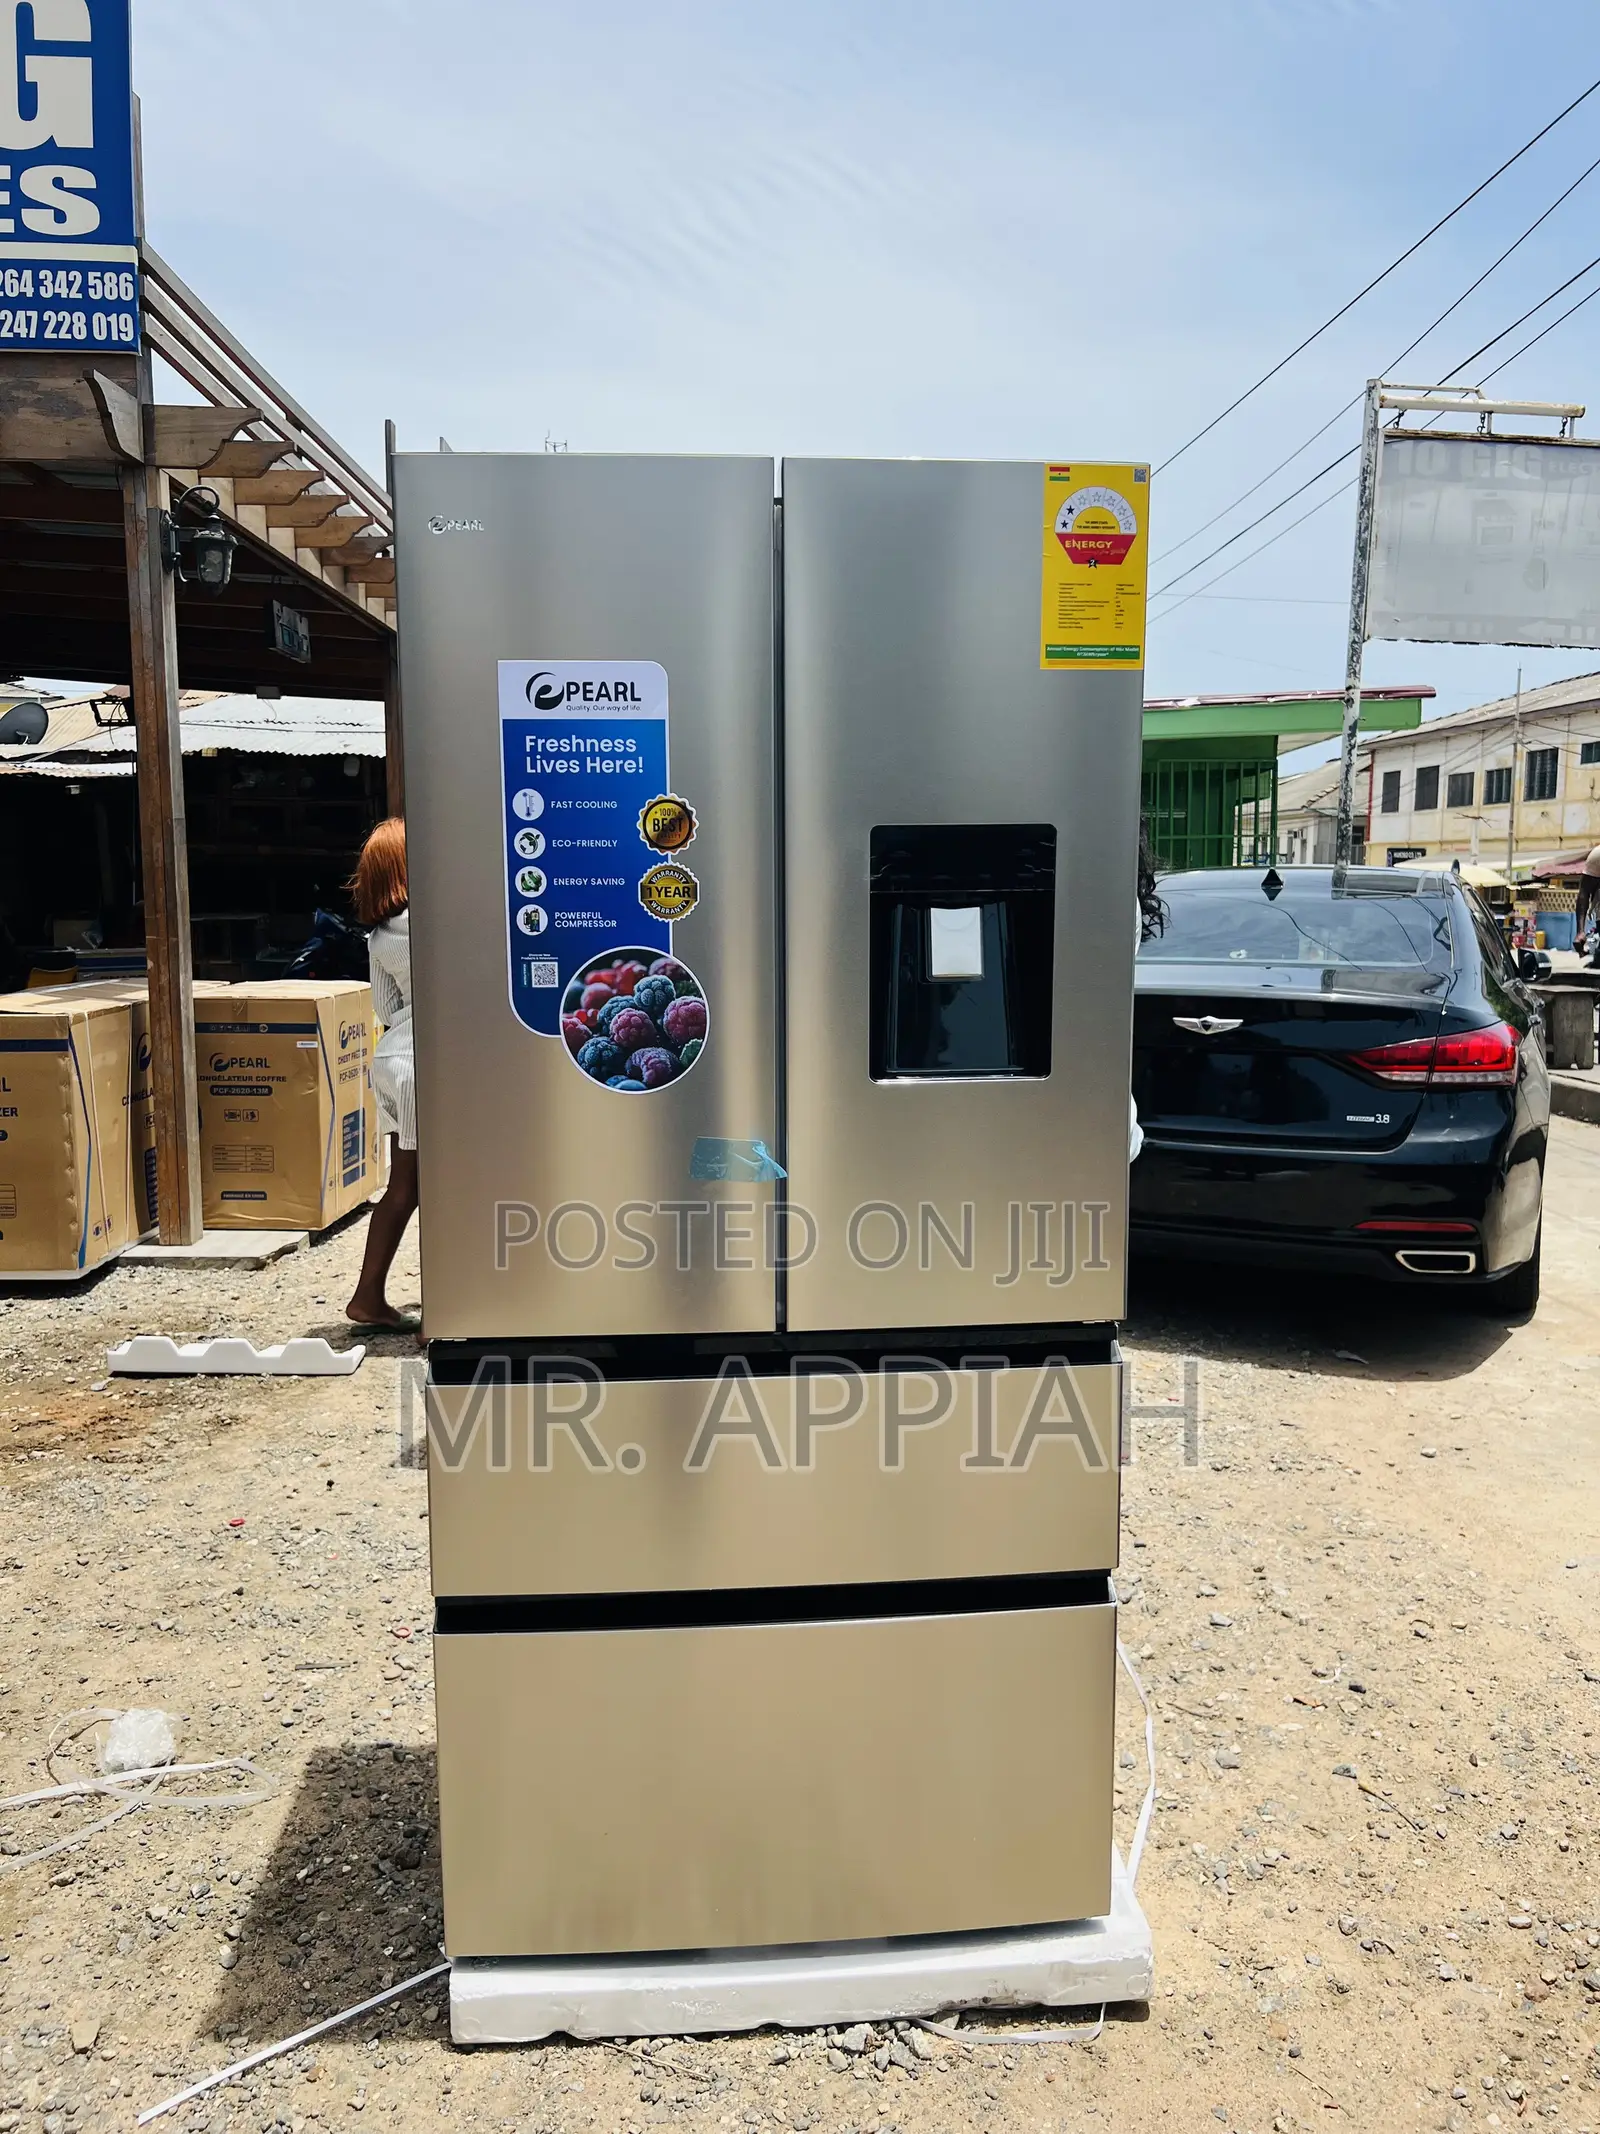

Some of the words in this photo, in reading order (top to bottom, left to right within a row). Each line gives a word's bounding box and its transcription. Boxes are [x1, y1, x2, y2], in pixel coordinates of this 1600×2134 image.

[0, 0, 94, 150] G
[38, 269, 83, 299] 342
[88, 271, 134, 301] 586
[0, 309, 38, 339] 247
[43, 310, 88, 340] 228
[92, 312, 134, 342] 019
[1391, 440, 1449, 476] 10
[447, 519, 485, 531] PEARL
[1065, 538, 1113, 550] ENERGY
[566, 681, 642, 702] PEARL
[606, 705, 621, 713] way
[525, 734, 637, 753] Freshness
[526, 754, 580, 774] Lives
[586, 756, 644, 774] Here!
[550, 800, 574, 809] FAST
[575, 800, 618, 809] COOLING
[660, 807, 678, 817] 100%
[652, 817, 684, 833] BEST
[552, 839, 618, 848] ECO-FRIENDLY
[553, 877, 589, 886] ENERGY
[590, 877, 626, 886] SAVING
[650, 870, 687, 884] WARRANTY
[646, 886, 653, 898] 1
[654, 886, 691, 898] YEAR
[650, 900, 687, 915] WARRANTY
[554, 911, 603, 920] POWERFUL
[554, 920, 617, 928] COMPRESSOR
[351, 1048, 368, 1060] FREEER
[230, 1057, 271, 1068] PEARL
[0, 1076, 12, 1092] L
[255, 1075, 287, 1083] COFFRE
